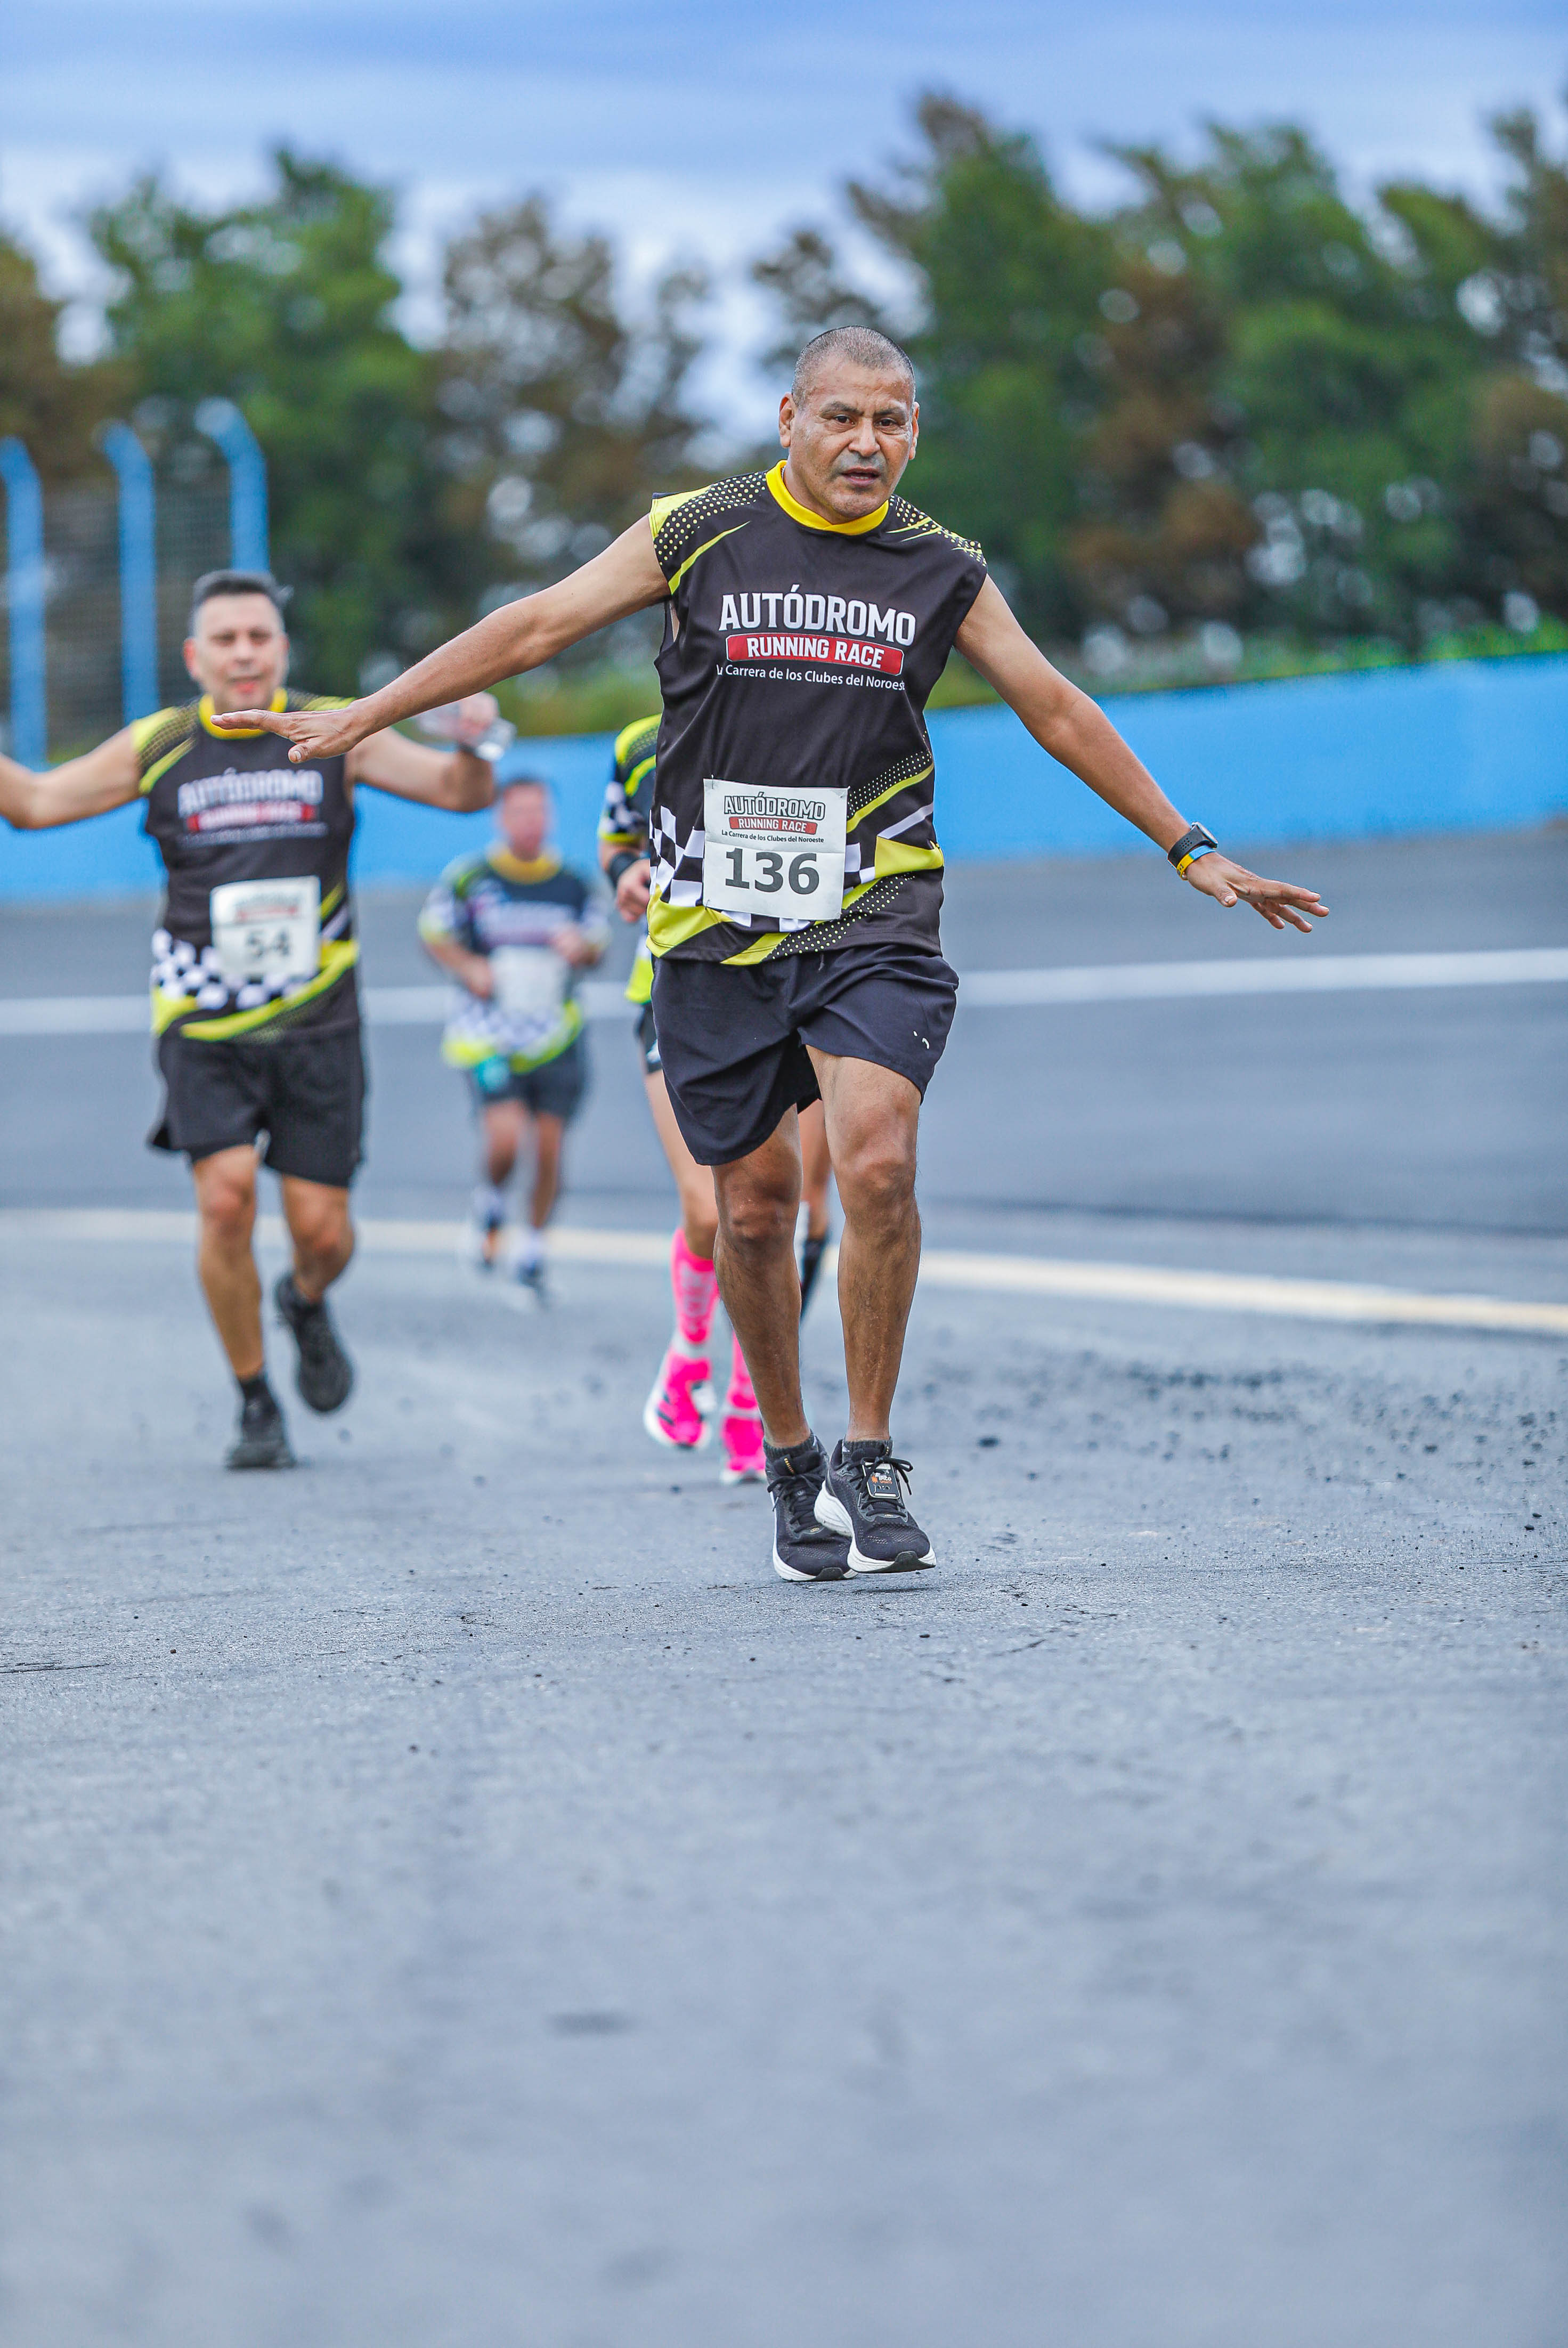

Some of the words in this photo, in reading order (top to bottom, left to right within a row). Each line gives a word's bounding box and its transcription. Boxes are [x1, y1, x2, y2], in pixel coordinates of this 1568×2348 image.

[719, 584, 916, 646] AUTÓDROMO
[746, 636, 830, 659] RUNNING
[835, 640, 884, 669] RACE
[725, 664, 766, 678] Carrera
[769, 667, 783, 679] de
[786, 668, 802, 681] los
[805, 670, 843, 685] Clubes
[846, 673, 864, 686] del
[724, 792, 825, 820] AUTÓDROMO
[738, 818, 779, 829] RUNNING
[782, 821, 807, 832] RACE
[725, 848, 819, 895] 136
[246, 928, 289, 958] 54
